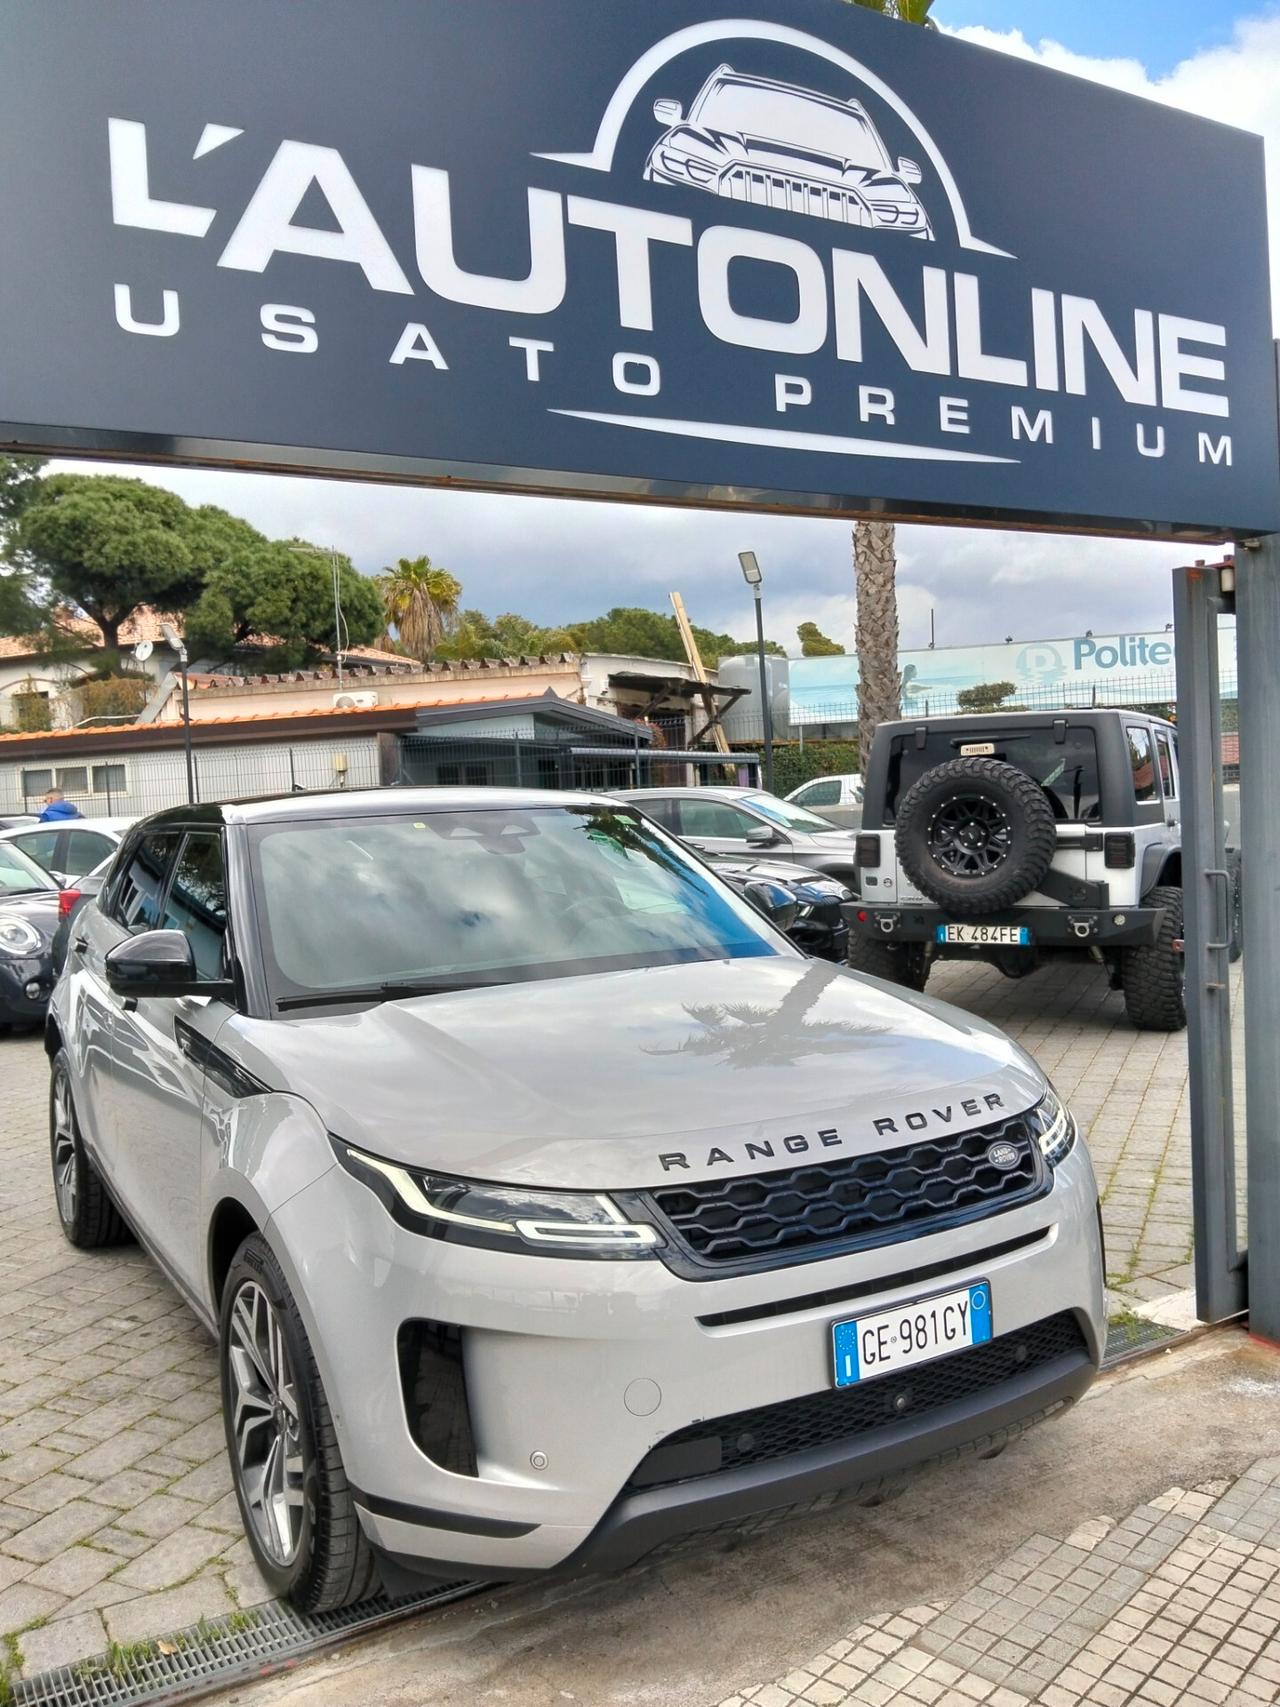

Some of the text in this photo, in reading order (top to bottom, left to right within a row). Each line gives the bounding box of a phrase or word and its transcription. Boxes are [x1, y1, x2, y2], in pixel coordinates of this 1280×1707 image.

[108, 117, 1230, 418] L'AUTONLINE
[114, 283, 1233, 466] USATO PREMIUM
[1074, 636, 1174, 670] Polite
[658, 1092, 1005, 1171] RANGE ROVER
